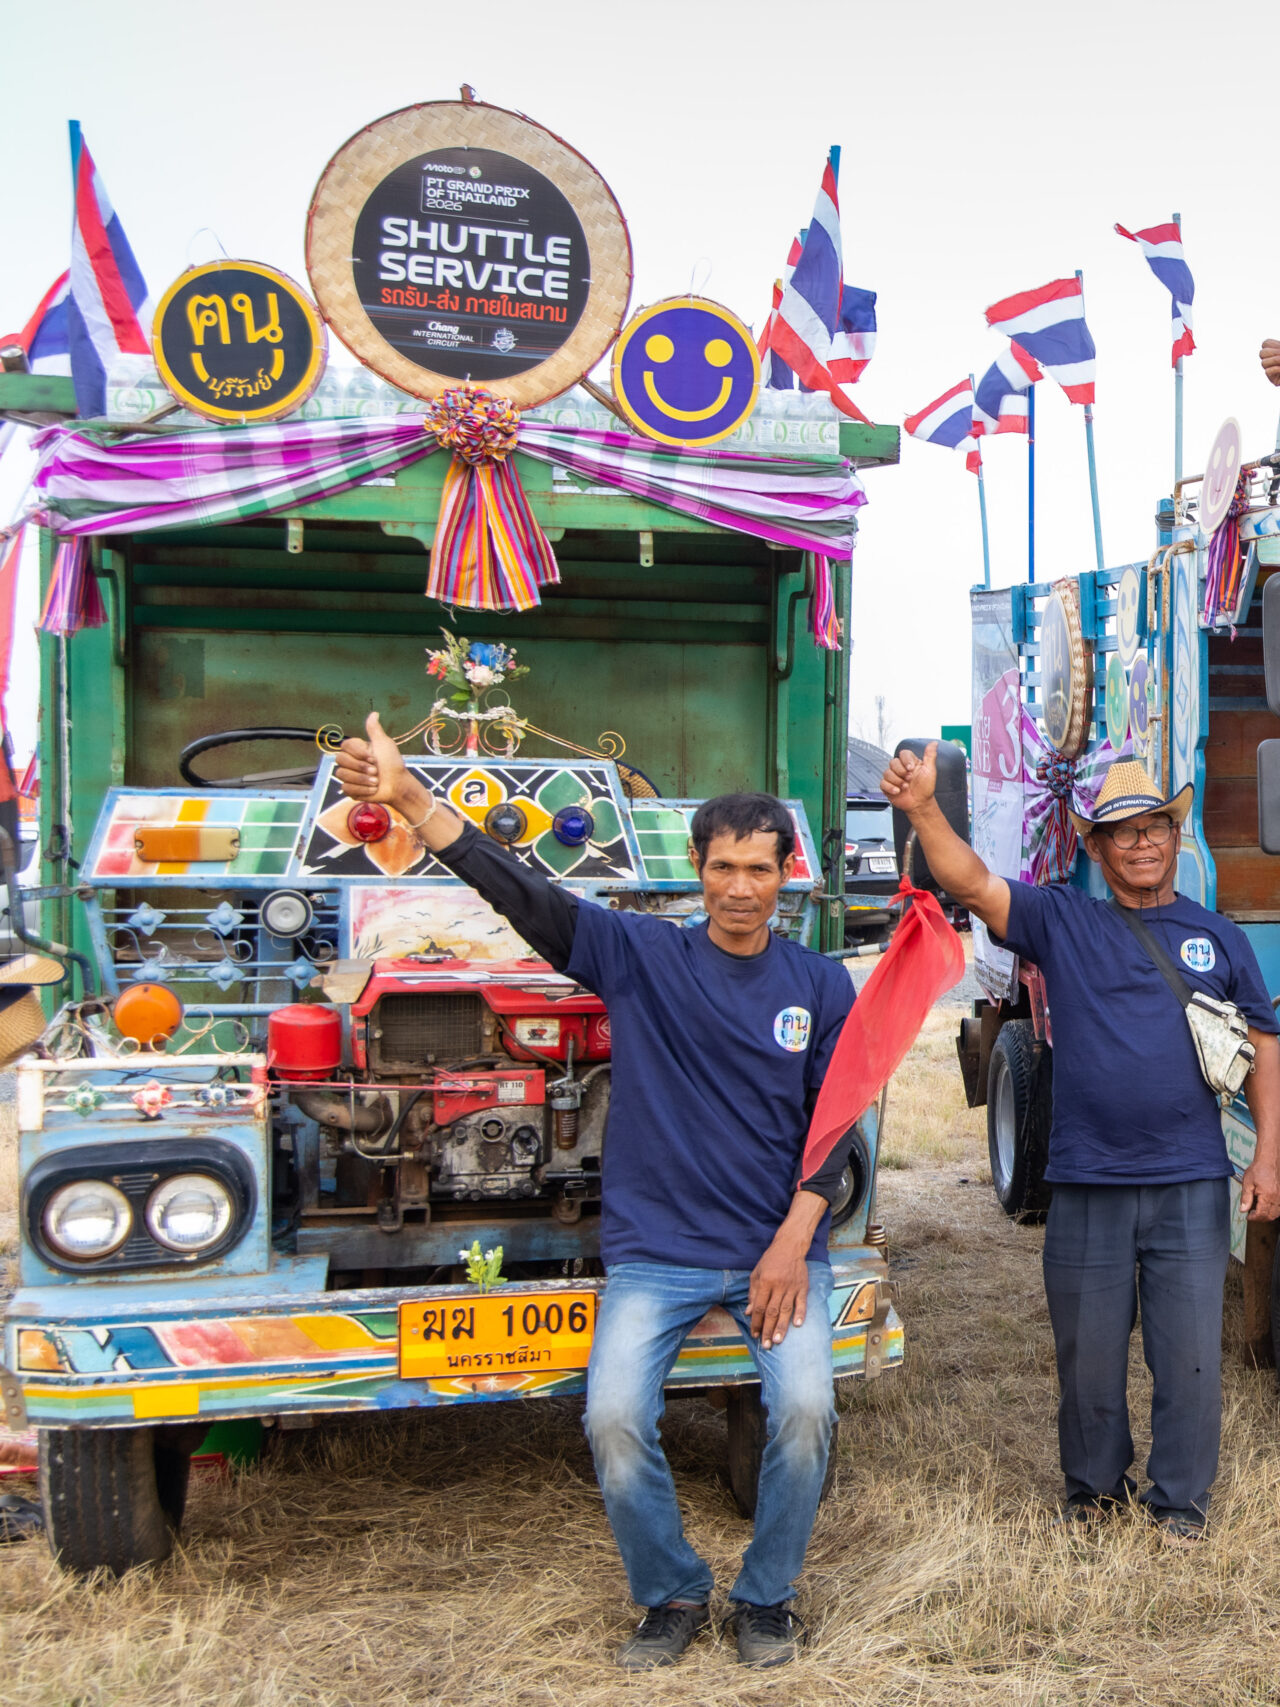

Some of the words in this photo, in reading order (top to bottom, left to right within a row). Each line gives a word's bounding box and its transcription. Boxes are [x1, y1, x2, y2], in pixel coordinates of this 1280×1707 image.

[426, 177, 445, 188] PT
[447, 180, 493, 195] GRAND
[495, 185, 530, 199] PRIX
[426, 188, 444, 199] OF
[446, 191, 518, 207] THAILAND
[426, 198, 463, 212] 2026
[381, 217, 572, 266] SHUTTLE
[379, 252, 570, 300] SERVICE
[381, 285, 460, 312] รถรับ-ส่ง
[464, 294, 568, 323] ภายในสนาม
[413, 329, 475, 343] INTERNATIONAL
[428, 321, 460, 334] Chang
[427, 338, 460, 348] CIRCUIT
[208, 368, 273, 399] บุรีรัมย์
[998, 685, 1022, 779] 3
[463, 780, 488, 807] a
[1113, 799, 1158, 809] INTERNATIONAL
[502, 1302, 588, 1336] 1006
[447, 1346, 551, 1367] นครราชสีมา
